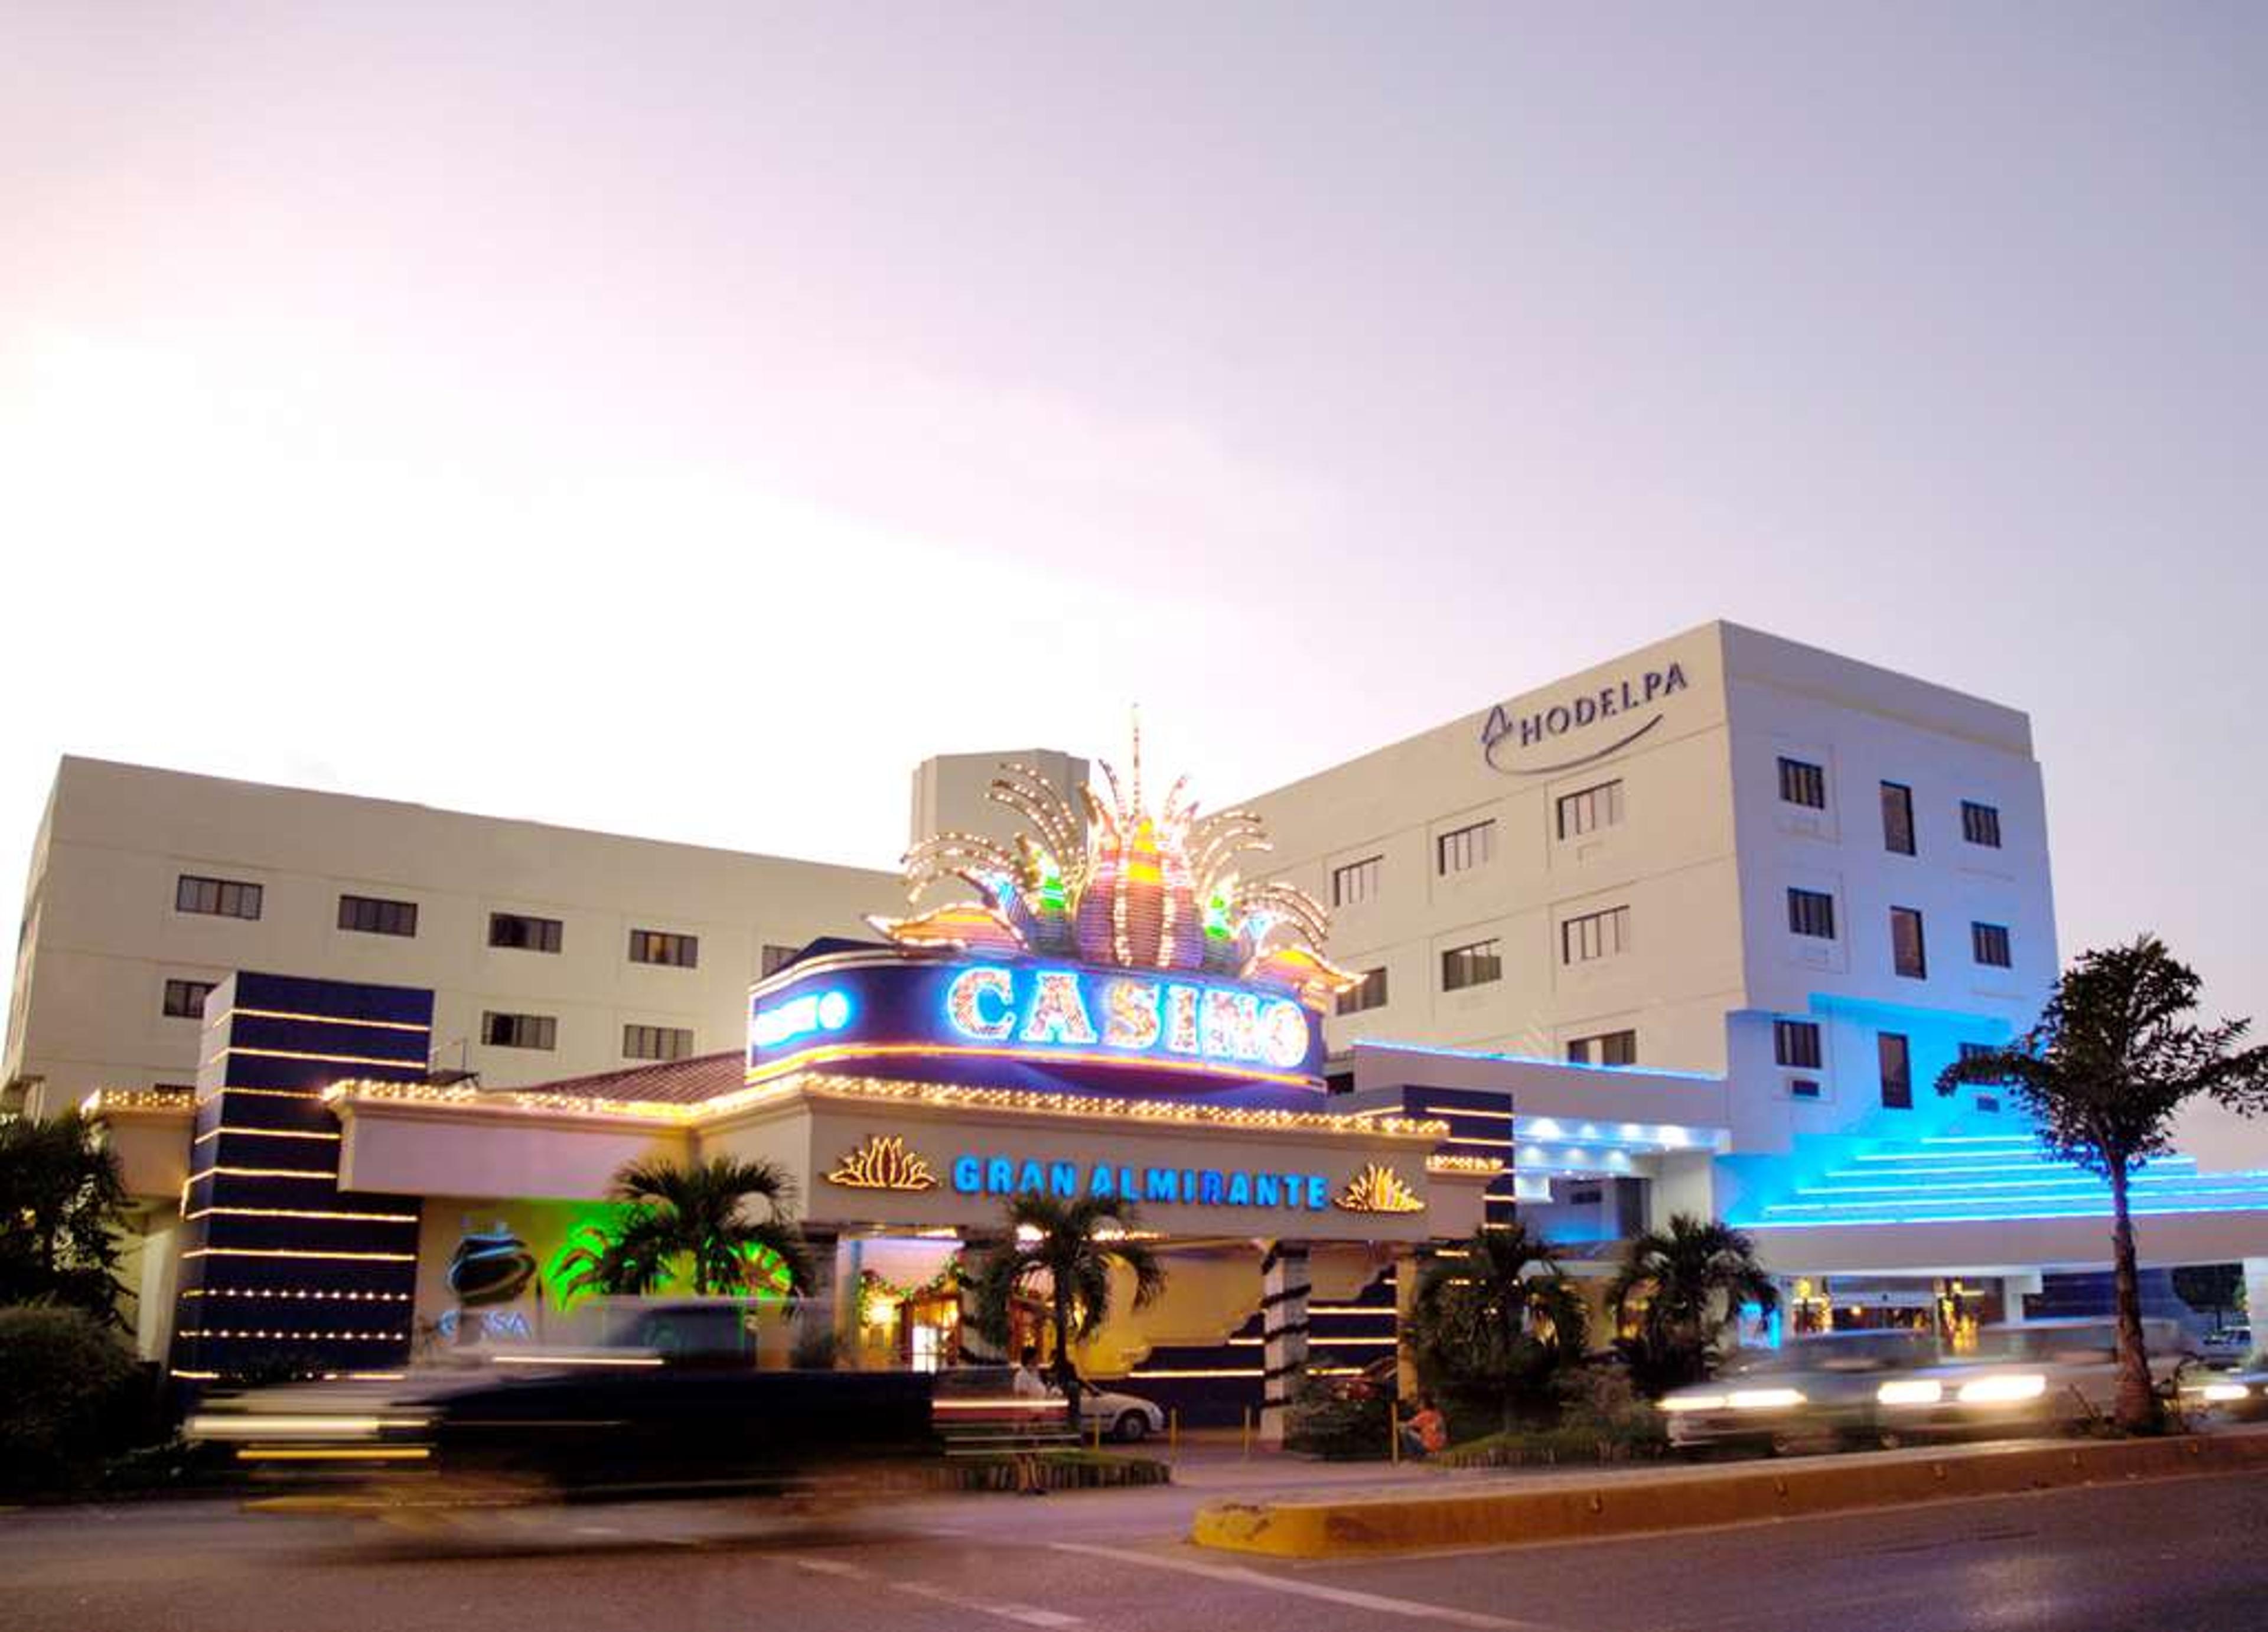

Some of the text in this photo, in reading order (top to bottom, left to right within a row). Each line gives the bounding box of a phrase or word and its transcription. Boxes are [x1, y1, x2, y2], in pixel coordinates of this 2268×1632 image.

[1520, 662, 1687, 747] HODELPA
[946, 966, 1309, 1068] CASINO
[951, 1154, 1329, 1210] GRAN ALMIRANTE
